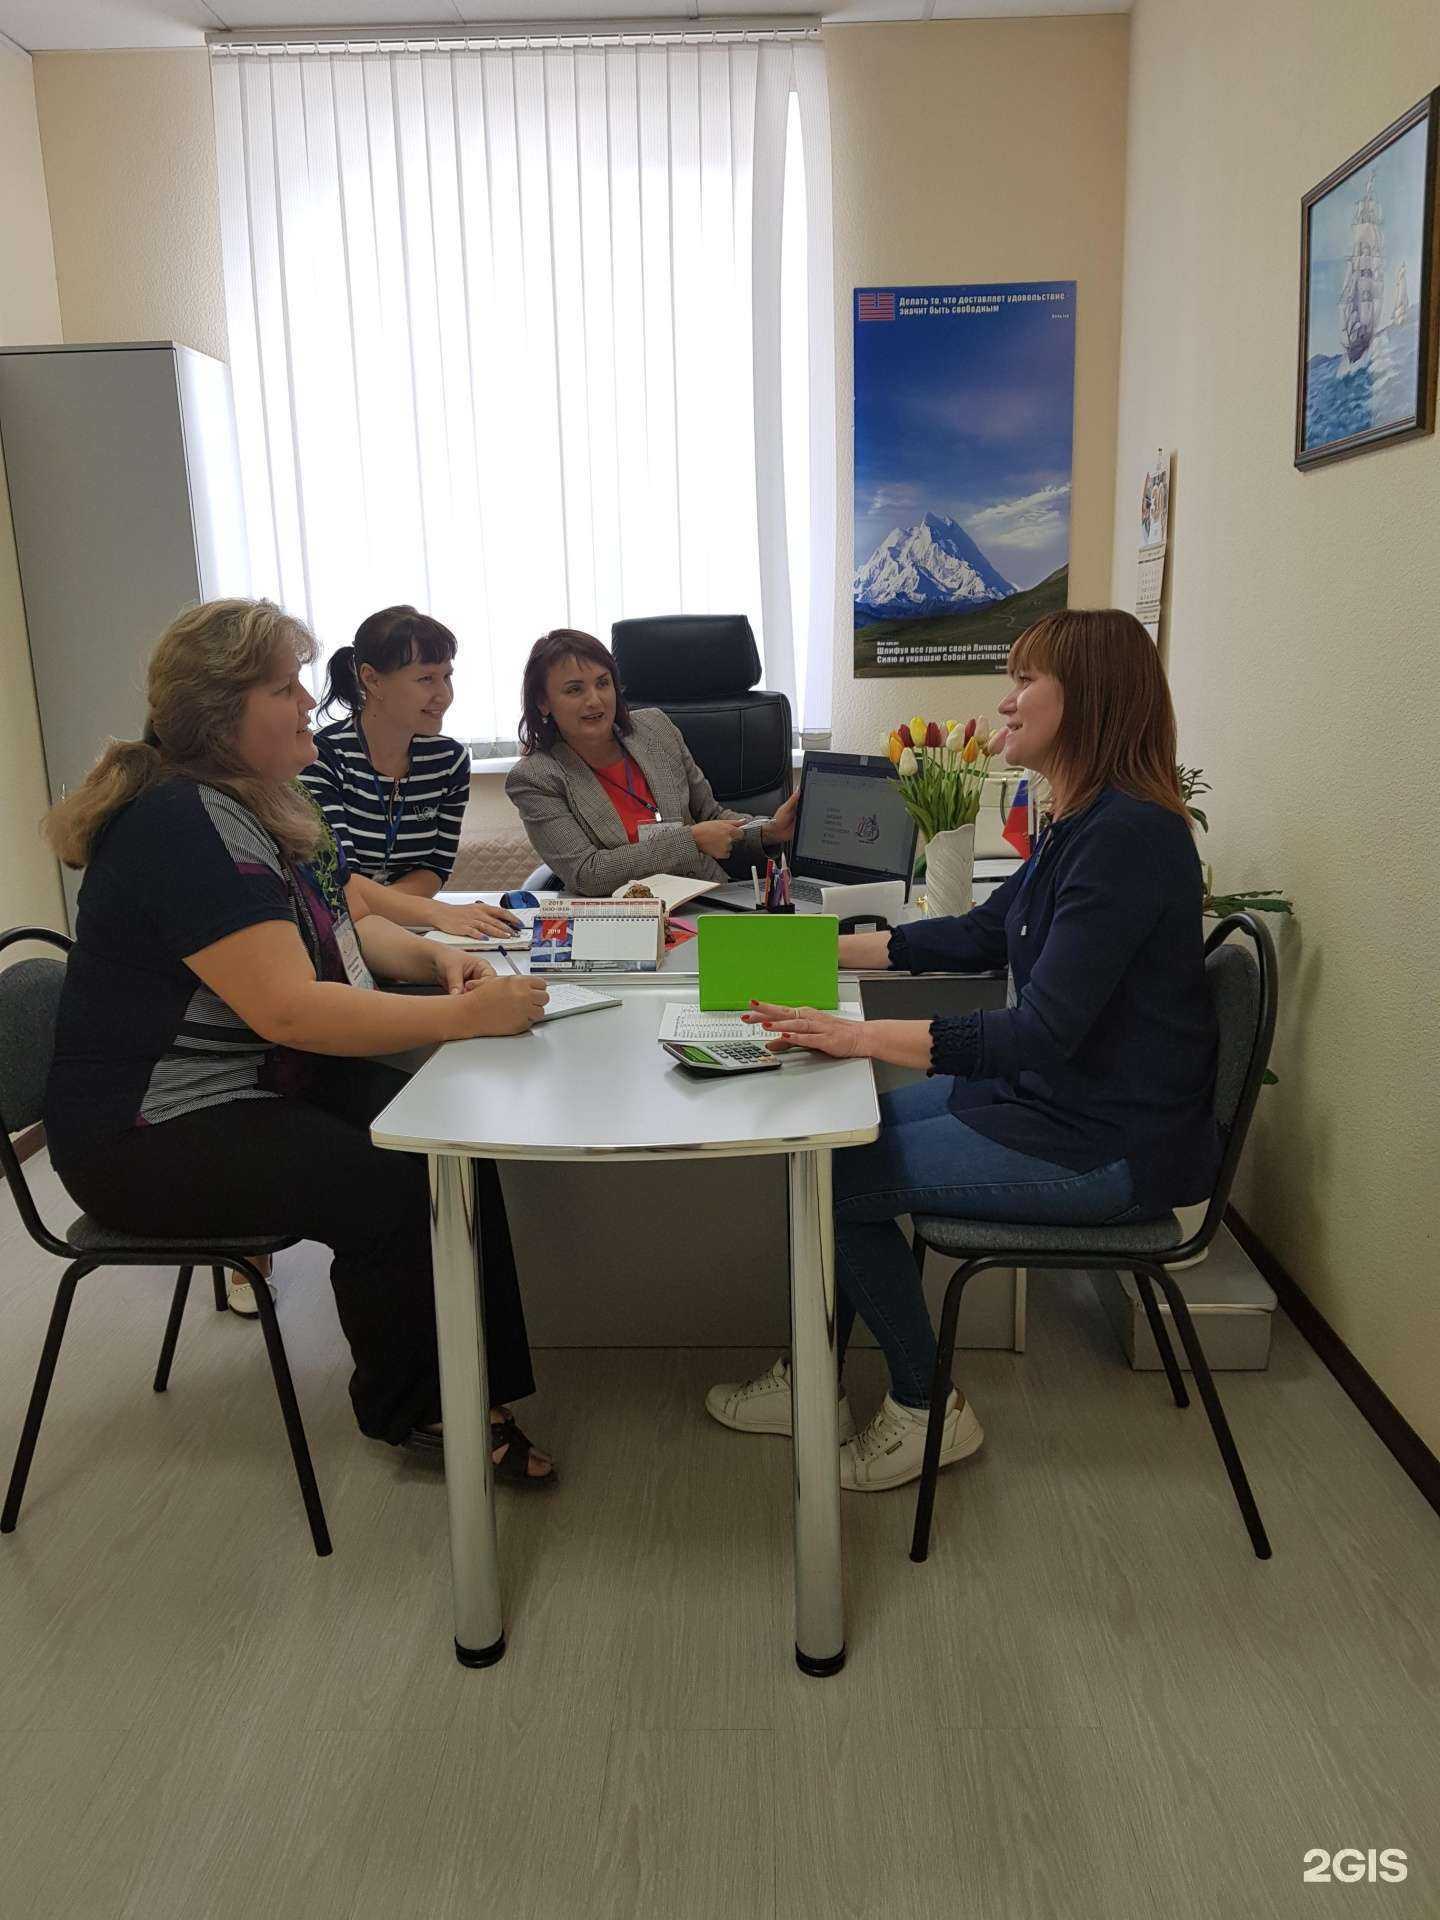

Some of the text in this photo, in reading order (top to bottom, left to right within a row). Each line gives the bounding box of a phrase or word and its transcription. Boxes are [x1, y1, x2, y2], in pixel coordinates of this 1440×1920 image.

[899, 297, 929, 307] Делать
[943, 296, 957, 304] что
[958, 295, 1005, 304] доставляет
[1007, 293, 1065, 303] удовольствие
[899, 304, 1000, 315] значит быть свободным
[876, 643, 1011, 655] Шлифуя все грани своей Личности
[876, 655, 898, 664] Сияю
[906, 654, 941, 664] украшаю
[942, 653, 966, 662] Собой
